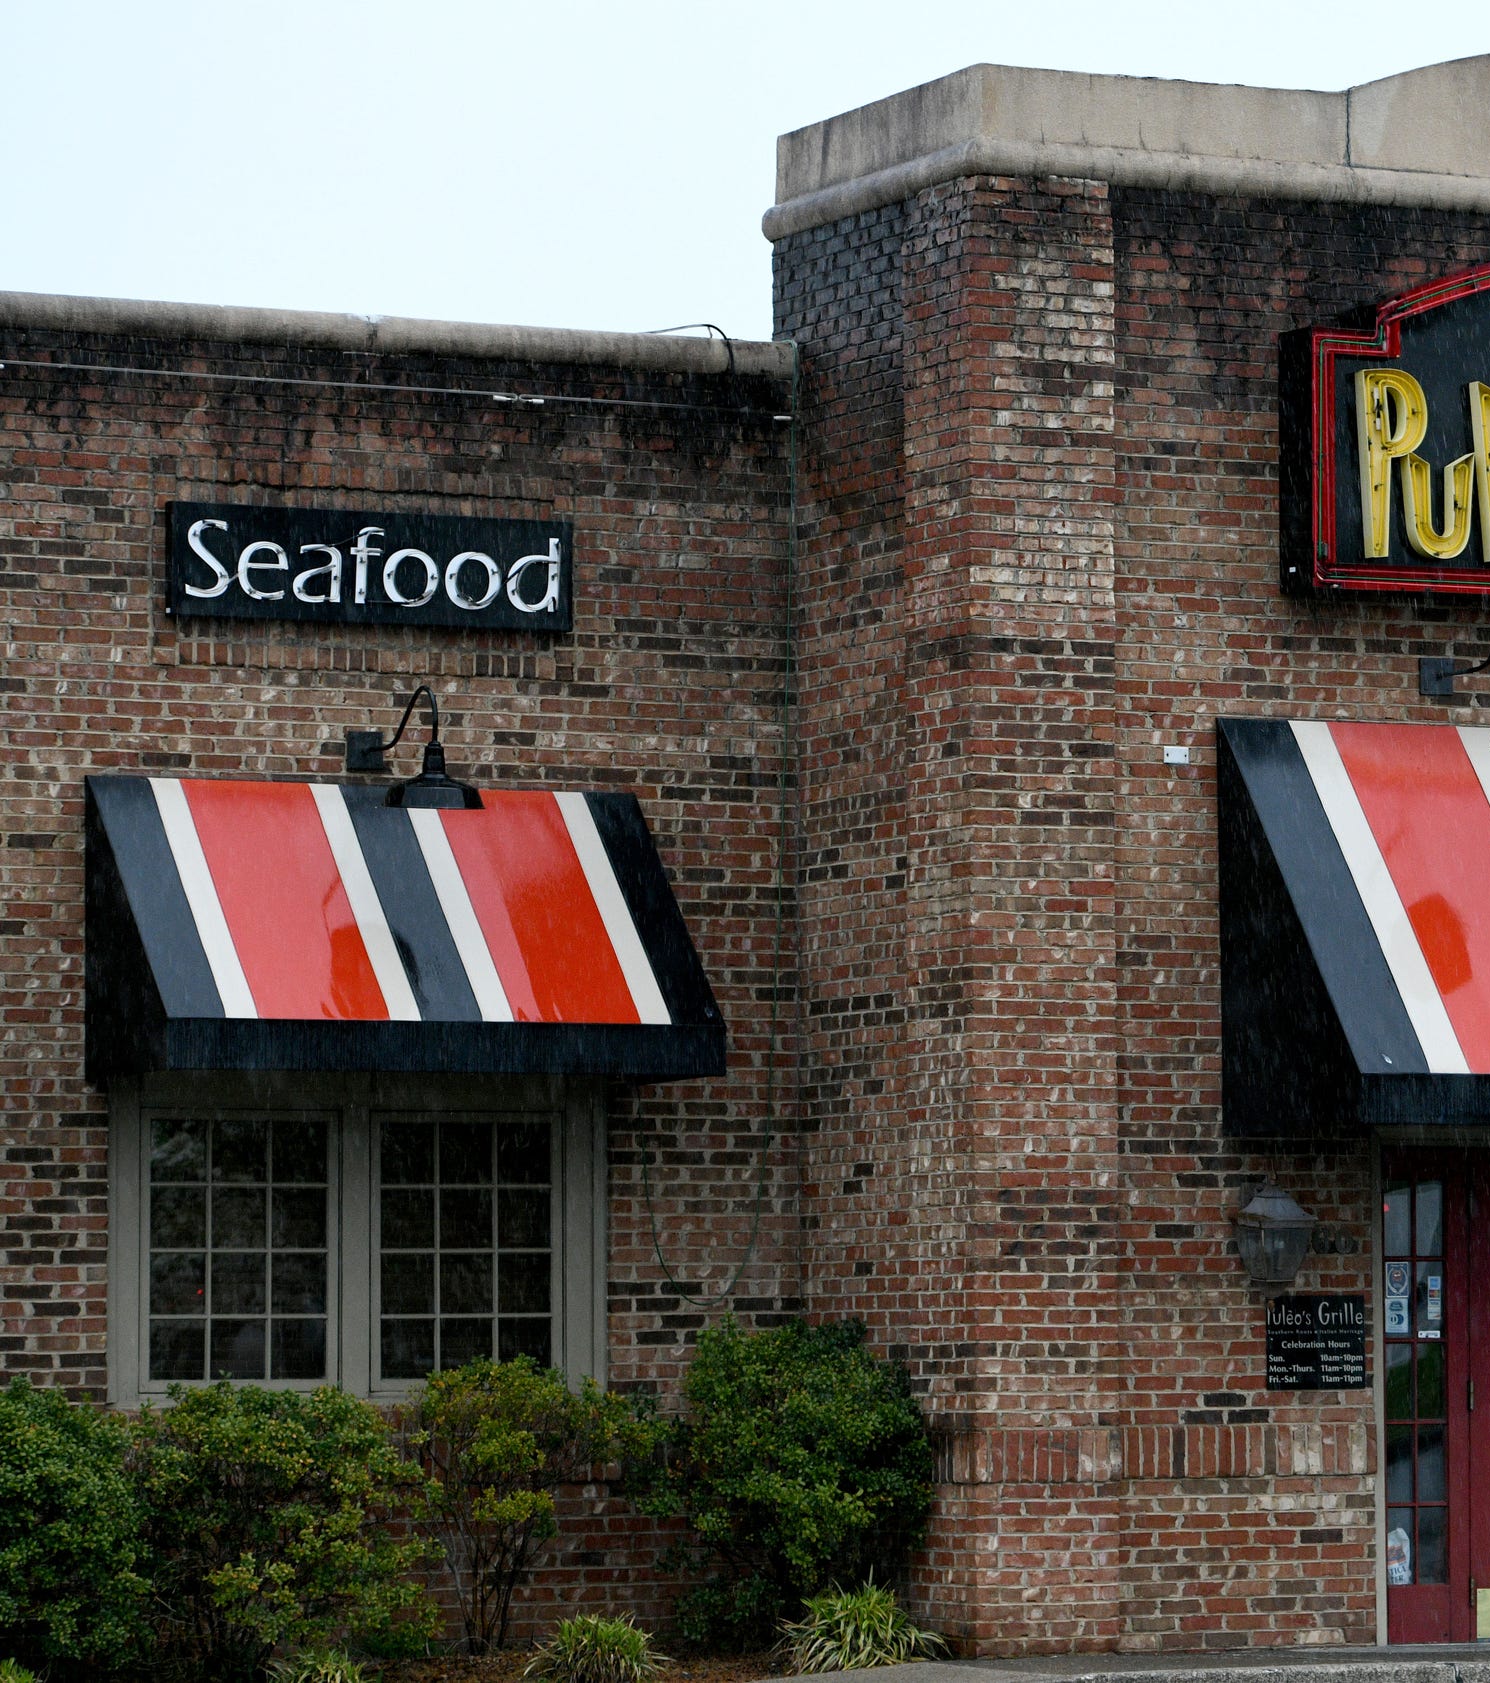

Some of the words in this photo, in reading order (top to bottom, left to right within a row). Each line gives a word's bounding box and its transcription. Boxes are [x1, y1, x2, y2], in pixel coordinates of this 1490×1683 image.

[184, 518, 562, 614] Seafood
[1318, 1301, 1363, 1326] Grille
[1281, 1340, 1326, 1349] Celebration
[1327, 1340, 1351, 1349] Hours
[1268, 1354, 1285, 1362] Sun.
[1320, 1353, 1364, 1363] 10am-10pm
[1268, 1364, 1316, 1373] Mon.-Thurs.
[1320, 1364, 1363, 1374] 11am-10pm
[1268, 1375, 1299, 1383] Fri.-Sat.
[1321, 1375, 1363, 1384] 11am-11pm
